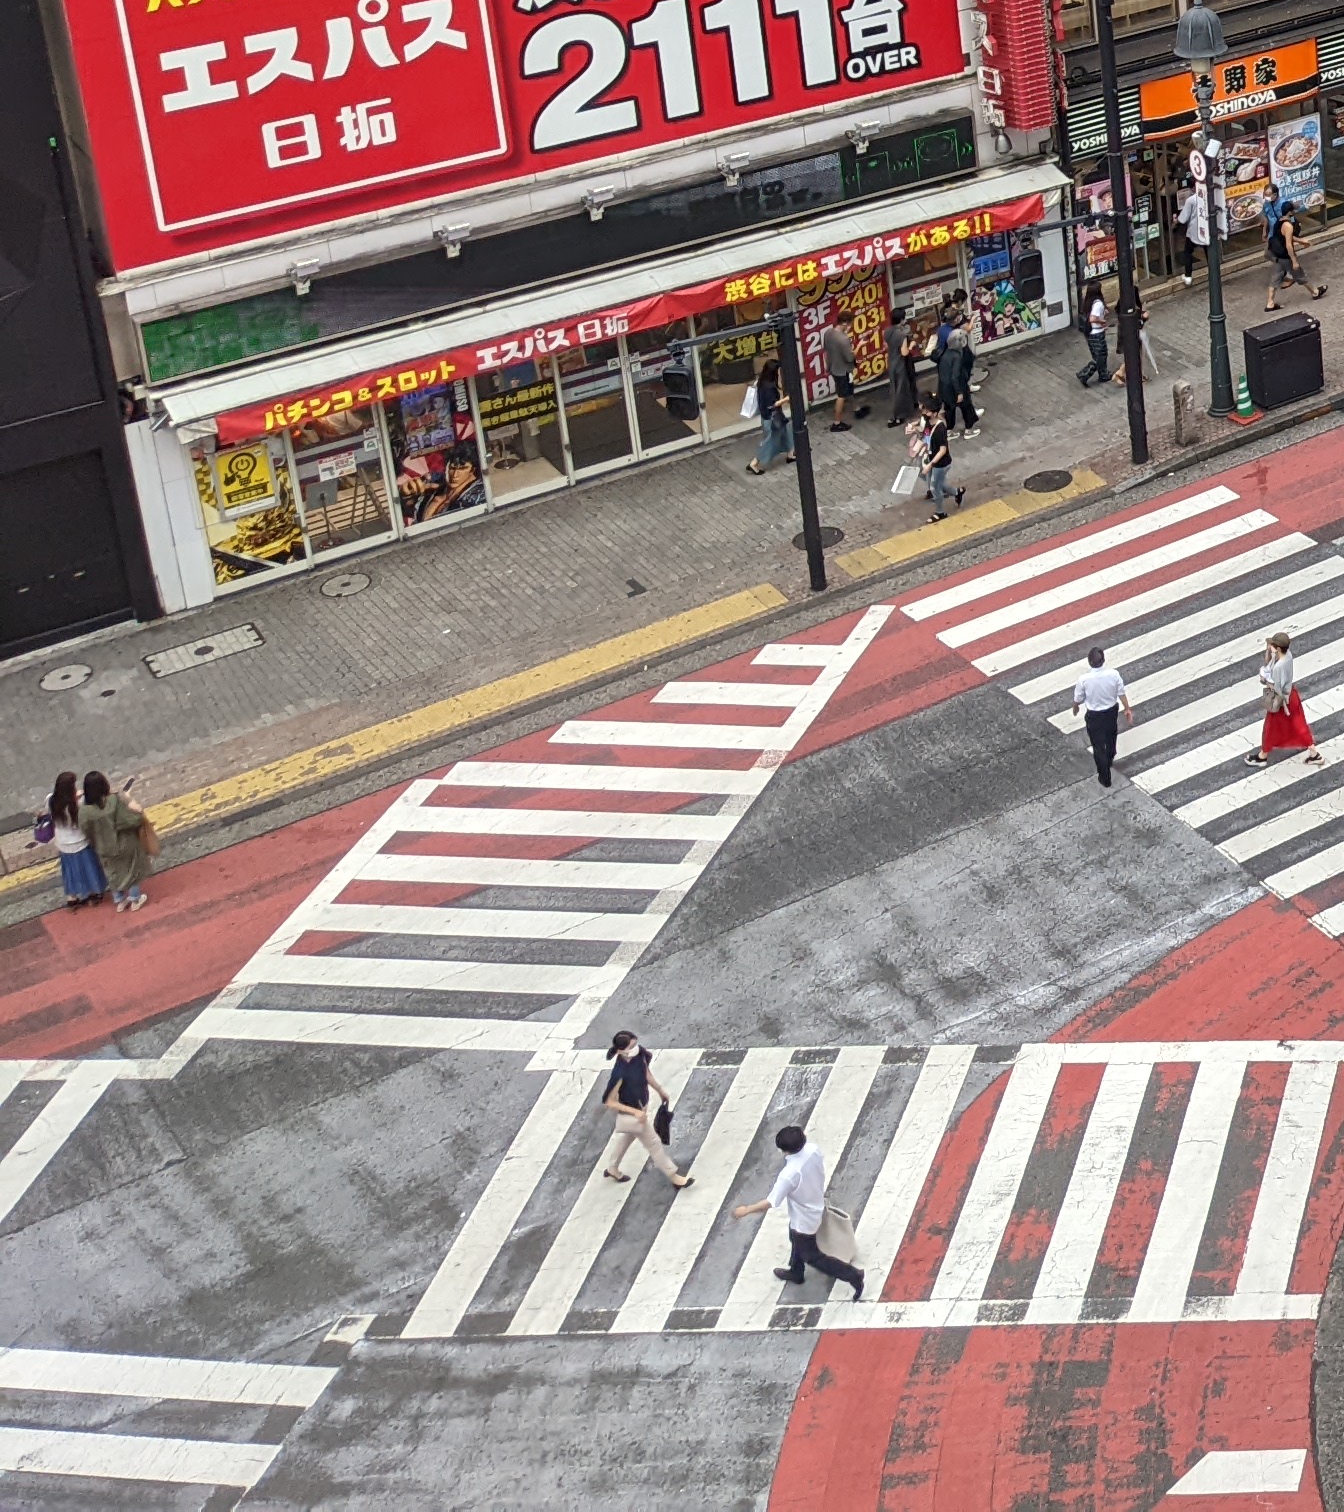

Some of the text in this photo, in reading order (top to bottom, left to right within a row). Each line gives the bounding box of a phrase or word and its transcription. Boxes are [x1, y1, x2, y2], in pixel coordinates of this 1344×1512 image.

[843, 42, 921, 84] OVER
[260, 96, 401, 171] 日拓
[1071, 123, 1141, 155] YOSHIOYA
[1193, 154, 1202, 177] 3
[723, 211, 994, 303] 渋谷にはエスパスがある!!
[802, 299, 832, 330] 3F
[476, 311, 630, 372] エスパス 日拓
